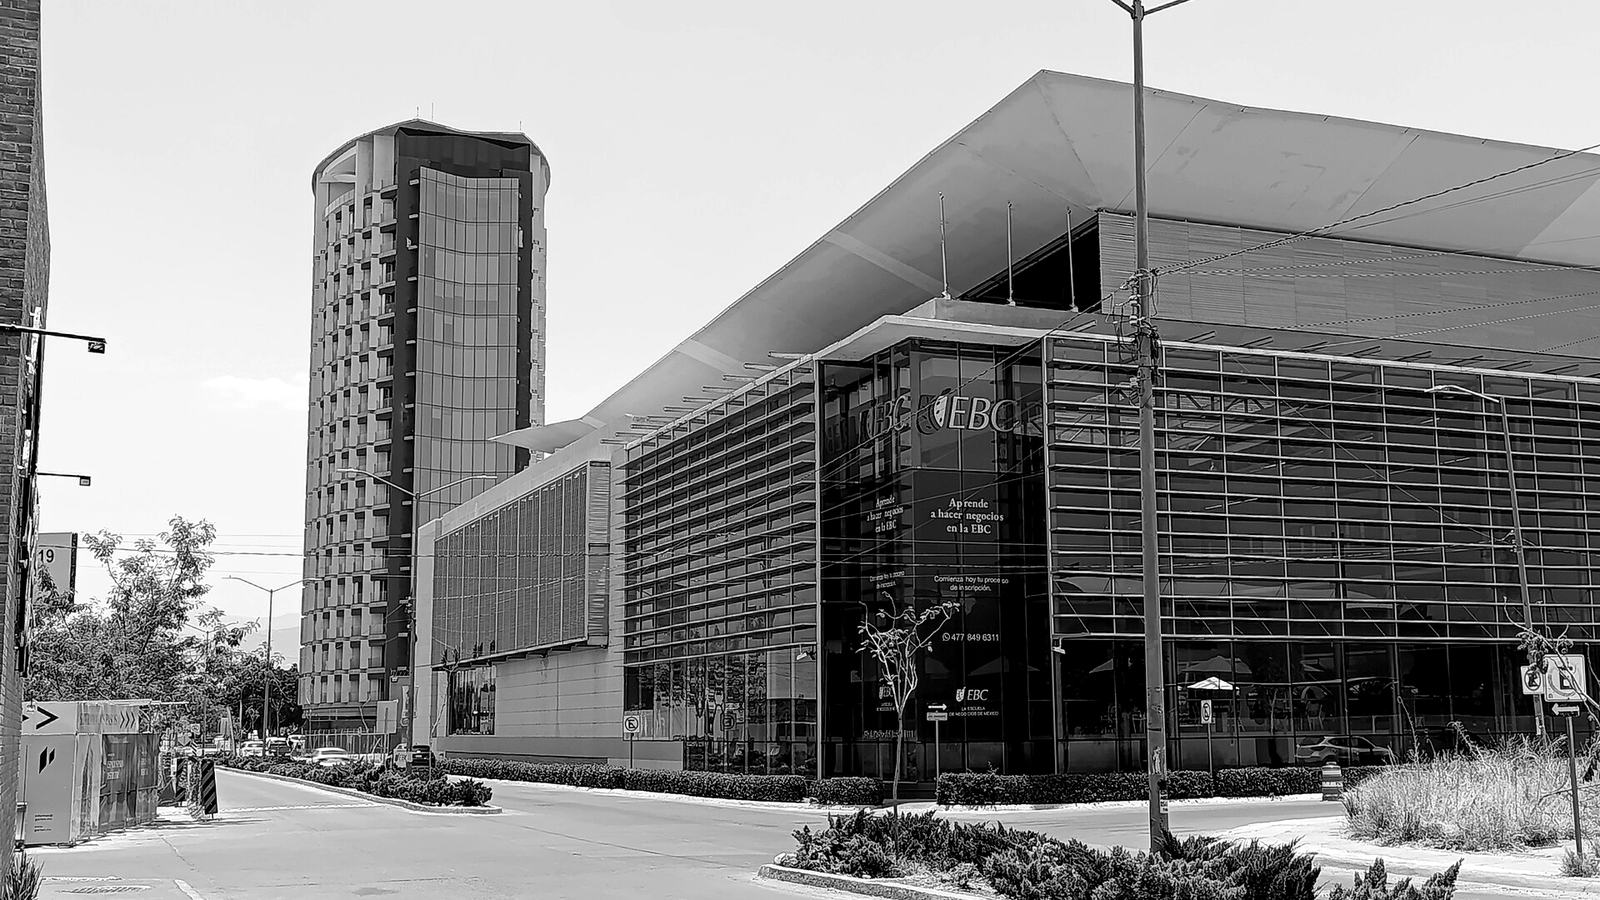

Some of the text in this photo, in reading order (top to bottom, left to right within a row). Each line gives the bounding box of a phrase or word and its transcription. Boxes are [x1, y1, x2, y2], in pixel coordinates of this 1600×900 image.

[948, 396, 1020, 433] EBC
[948, 498, 989, 510] Aprende
[930, 508, 1004, 523] a hacer negocios
[946, 523, 991, 534] en la EBC
[38, 549, 54, 563] 19
[933, 575, 963, 583] Comienza
[965, 576, 976, 584] hoy
[951, 632, 999, 641] 477 849 6311
[967, 689, 989, 700] EBC
